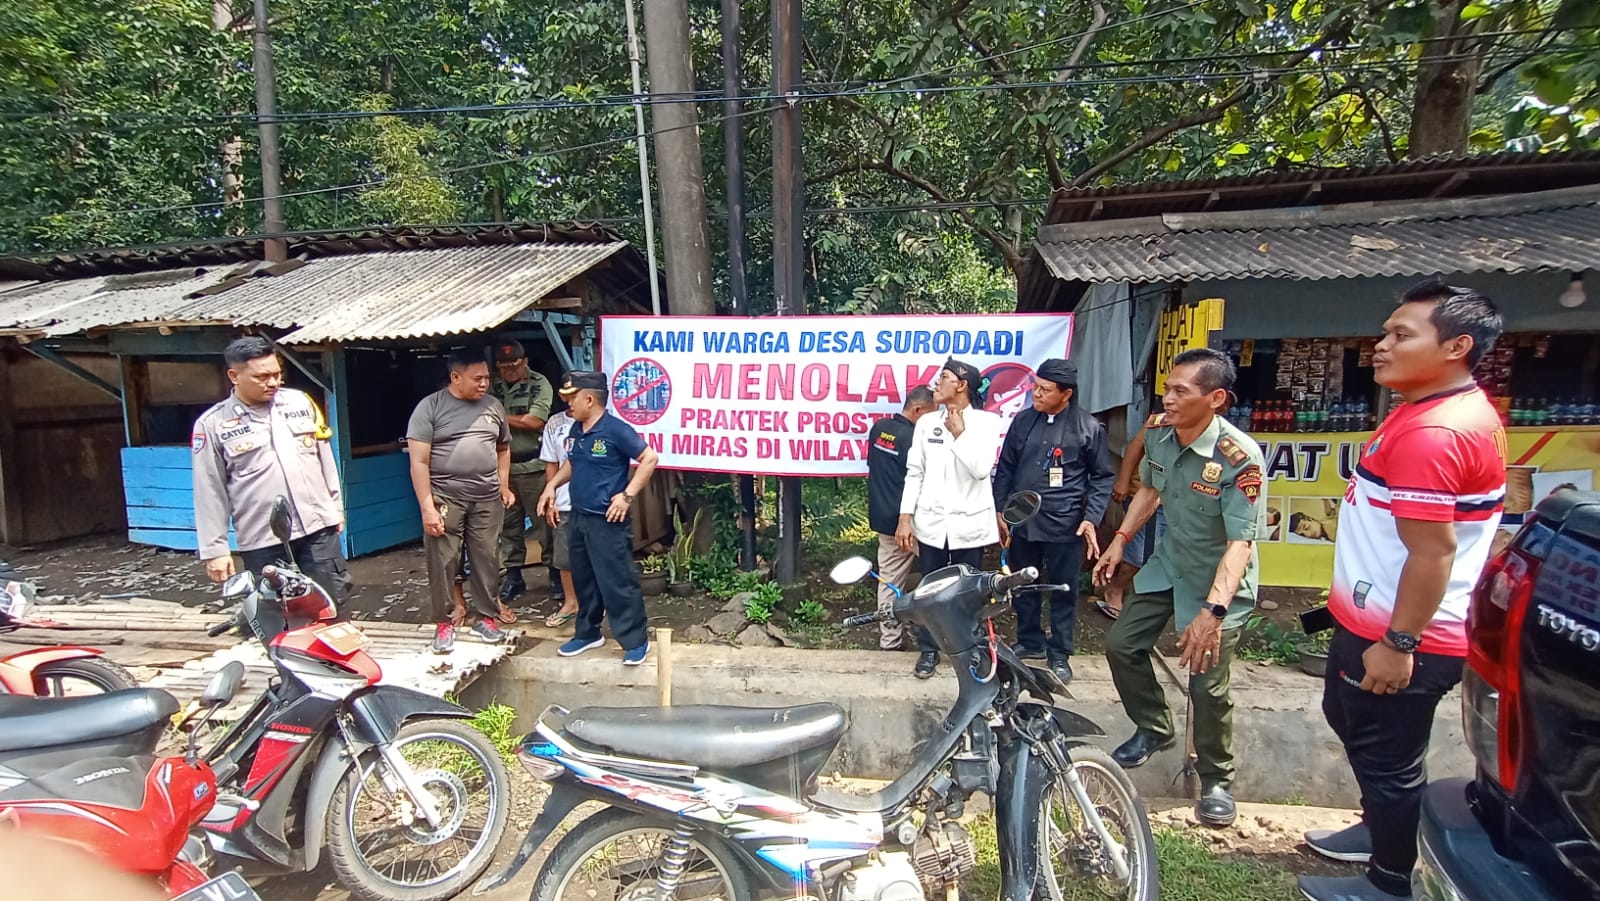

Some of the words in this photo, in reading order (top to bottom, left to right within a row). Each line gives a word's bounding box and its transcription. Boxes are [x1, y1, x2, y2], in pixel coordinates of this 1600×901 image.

[1161, 302, 1199, 339] PIJAT
[634, 331, 694, 352] KAMI
[704, 332, 790, 353] WARGA
[799, 331, 866, 353] DESA
[875, 330, 1024, 356] SURODADI
[692, 363, 942, 404] MENOLAK
[283, 409, 310, 419] POLRI
[680, 408, 789, 432] PRAKTEK
[797, 411, 892, 434] PROST
[641, 433, 664, 453] AN
[671, 434, 748, 458] MIRAS
[757, 438, 781, 459] DI
[788, 439, 870, 461] WILAY
[1262, 442, 1329, 480] AT
[1192, 482, 1219, 495] POLHUT
[1537, 603, 1600, 651] TOYO
[271, 722, 312, 734] HONDA
[73, 767, 130, 785] HONDA
